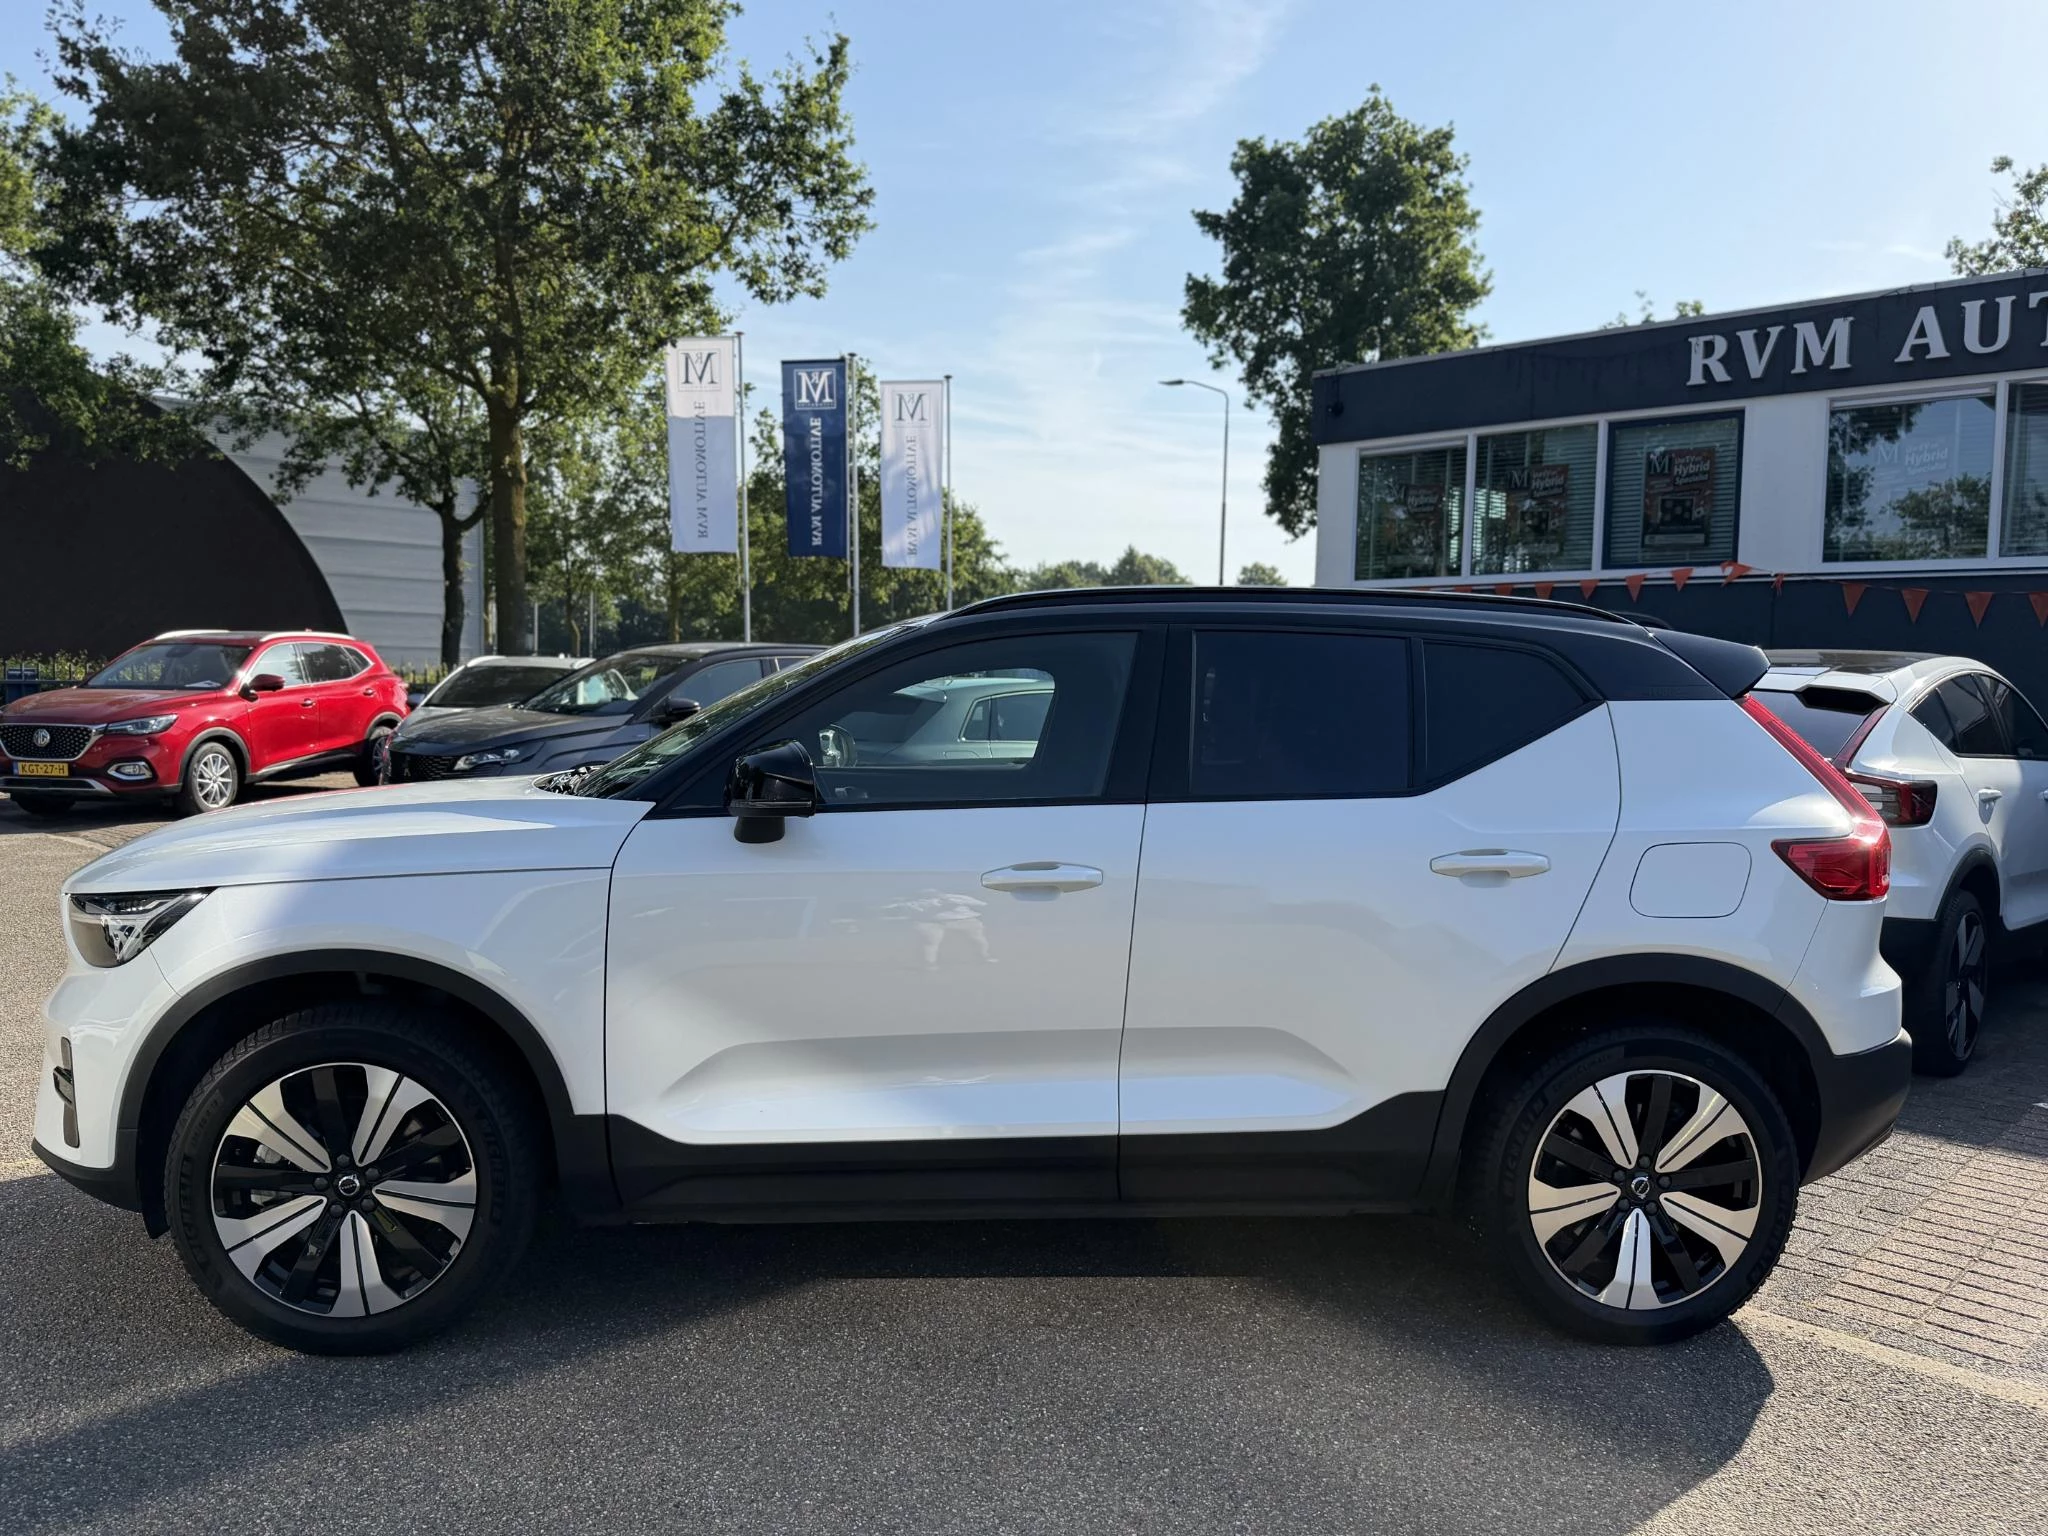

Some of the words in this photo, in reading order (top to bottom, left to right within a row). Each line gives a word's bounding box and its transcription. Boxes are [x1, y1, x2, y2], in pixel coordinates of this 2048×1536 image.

[1686, 316, 1855, 387] RVM
[1905, 447, 1948, 466] Hybrid
[1673, 460, 1710, 477] Hybrid
[1531, 474, 1564, 490] Hybrid
[21, 763, 65, 775] KGT-27-H
